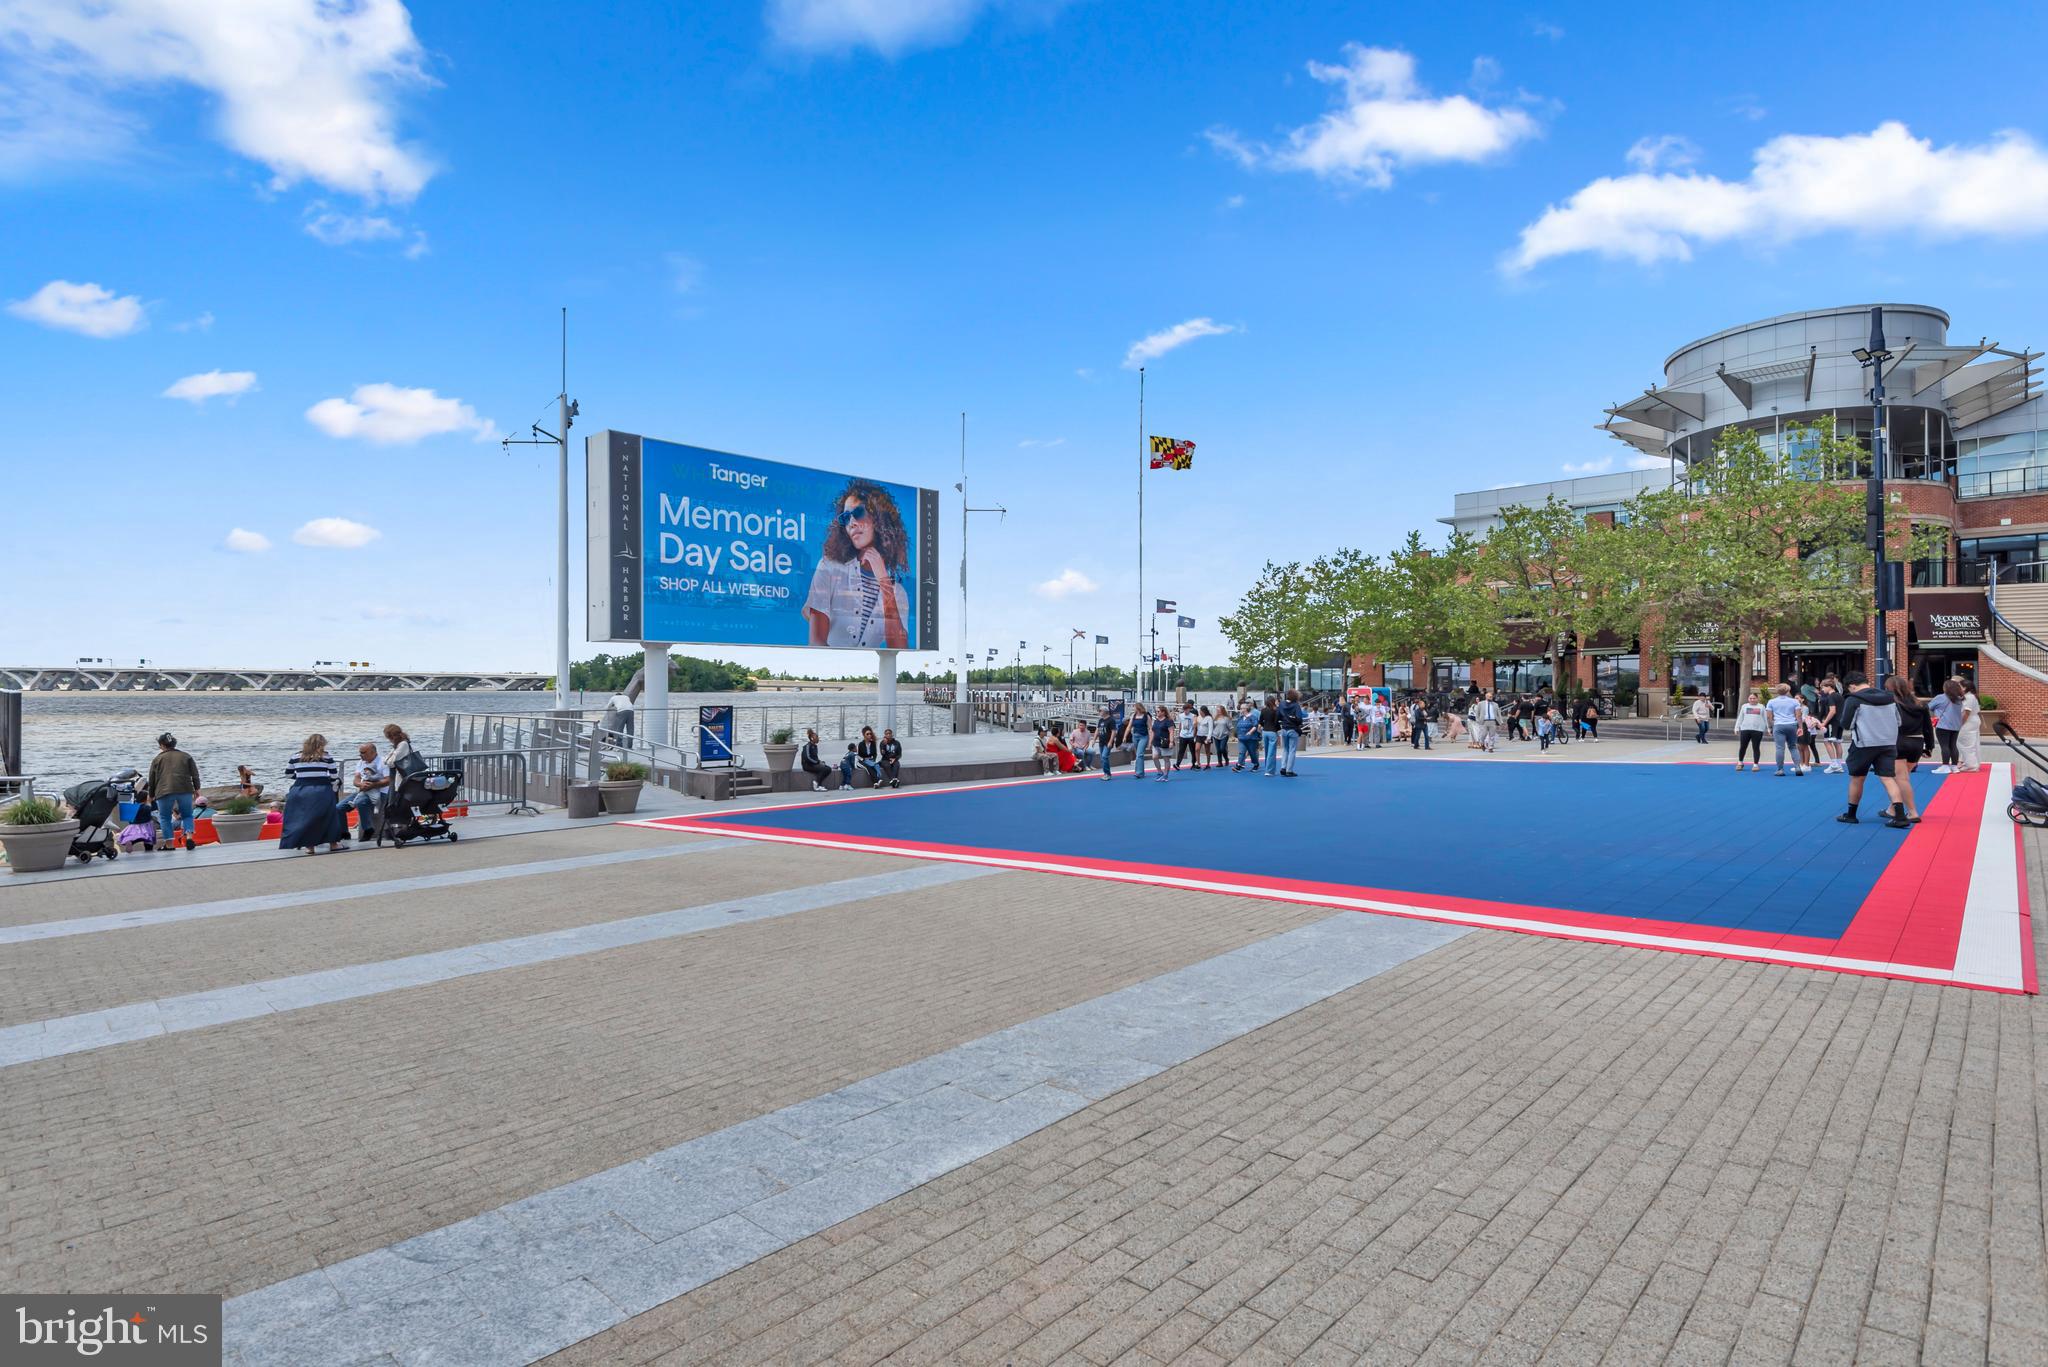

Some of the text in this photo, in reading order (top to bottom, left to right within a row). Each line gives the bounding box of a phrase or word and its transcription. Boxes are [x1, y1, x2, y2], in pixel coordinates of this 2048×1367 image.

[709, 463, 768, 490] Tanger
[622, 454, 630, 621] NATIONAL HARBOR
[659, 492, 806, 542] Memorial
[659, 531, 793, 576] Day Sale
[659, 576, 790, 599] SHOP ALL WEEKEND
